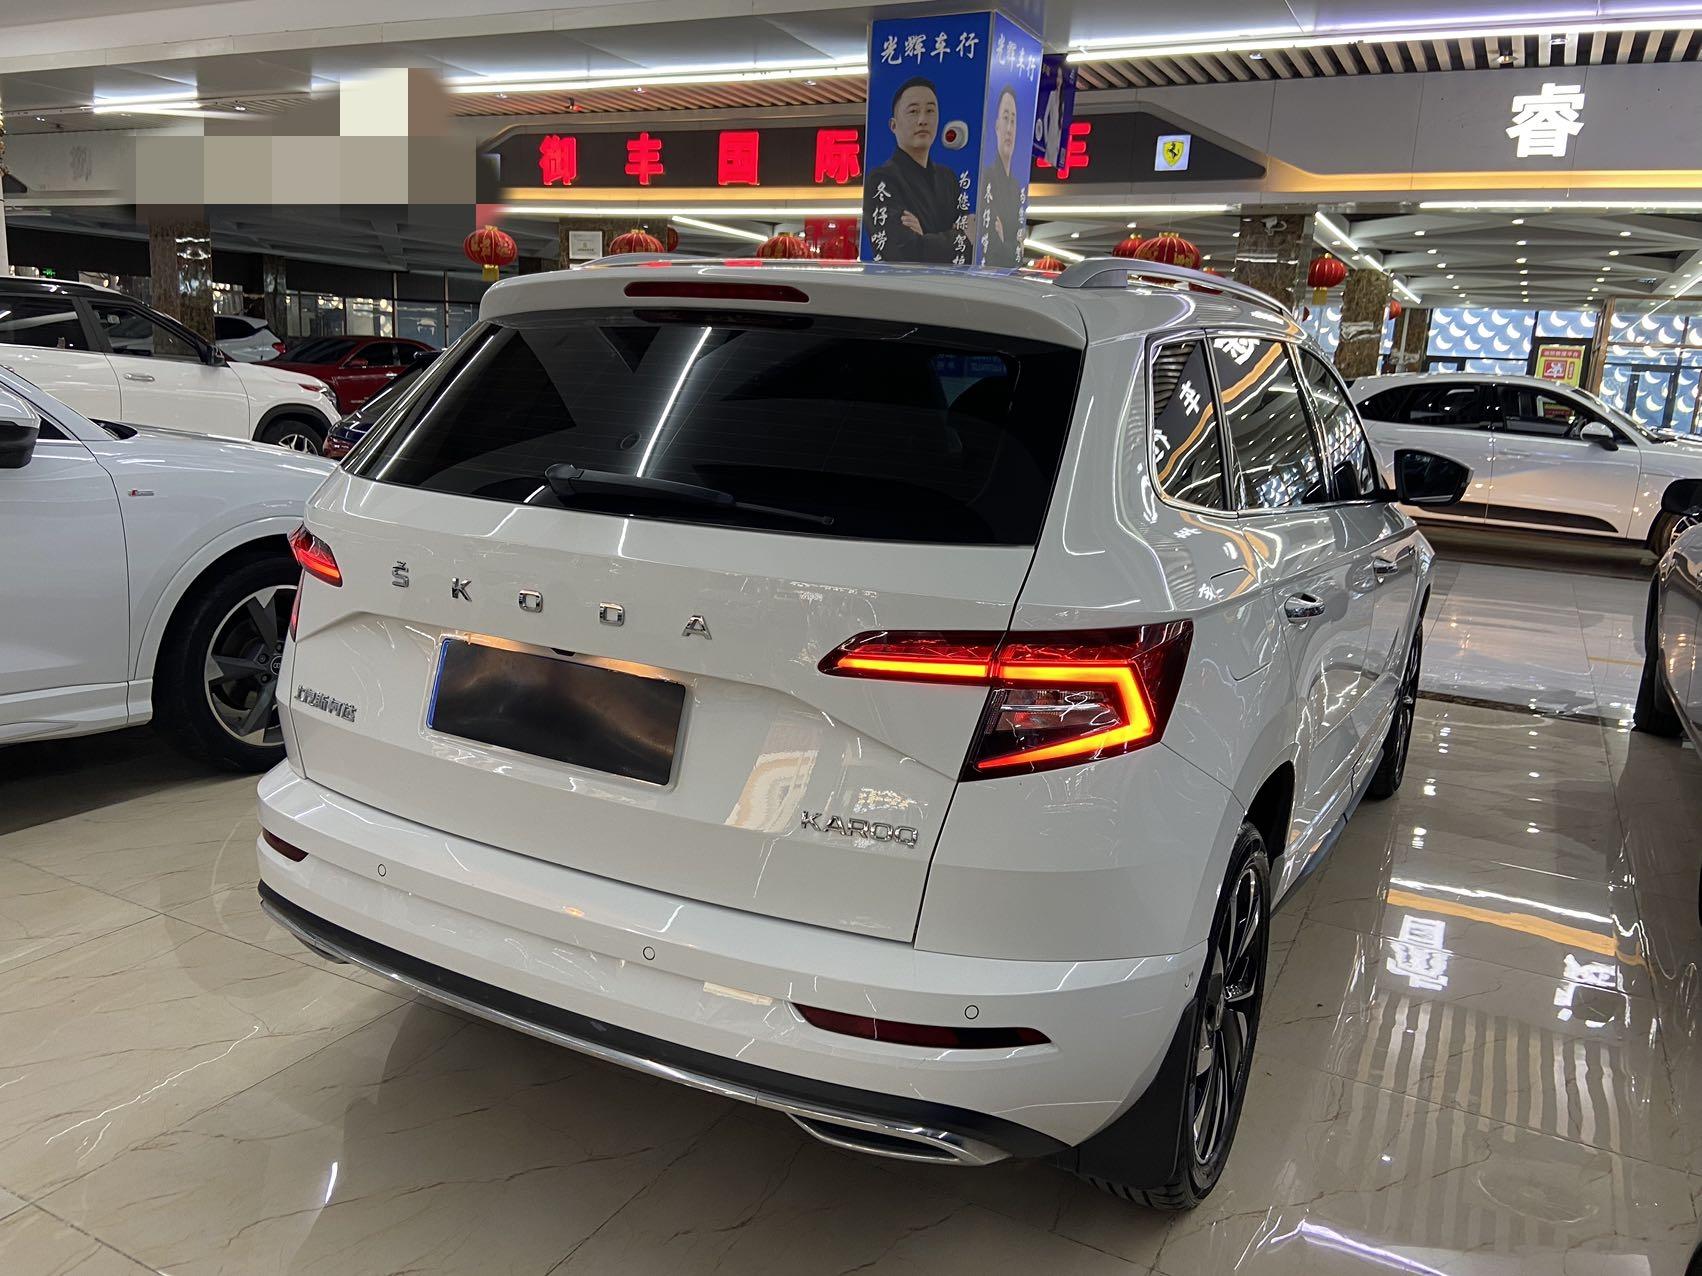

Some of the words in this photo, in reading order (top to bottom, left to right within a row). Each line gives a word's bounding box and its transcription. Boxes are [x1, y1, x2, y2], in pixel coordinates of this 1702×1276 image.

[880, 32, 979, 65] 光辉车行
[1505, 83, 1585, 158] 睿
[391, 561, 713, 641] ŠKODA
[800, 811, 918, 849] KAROQ
